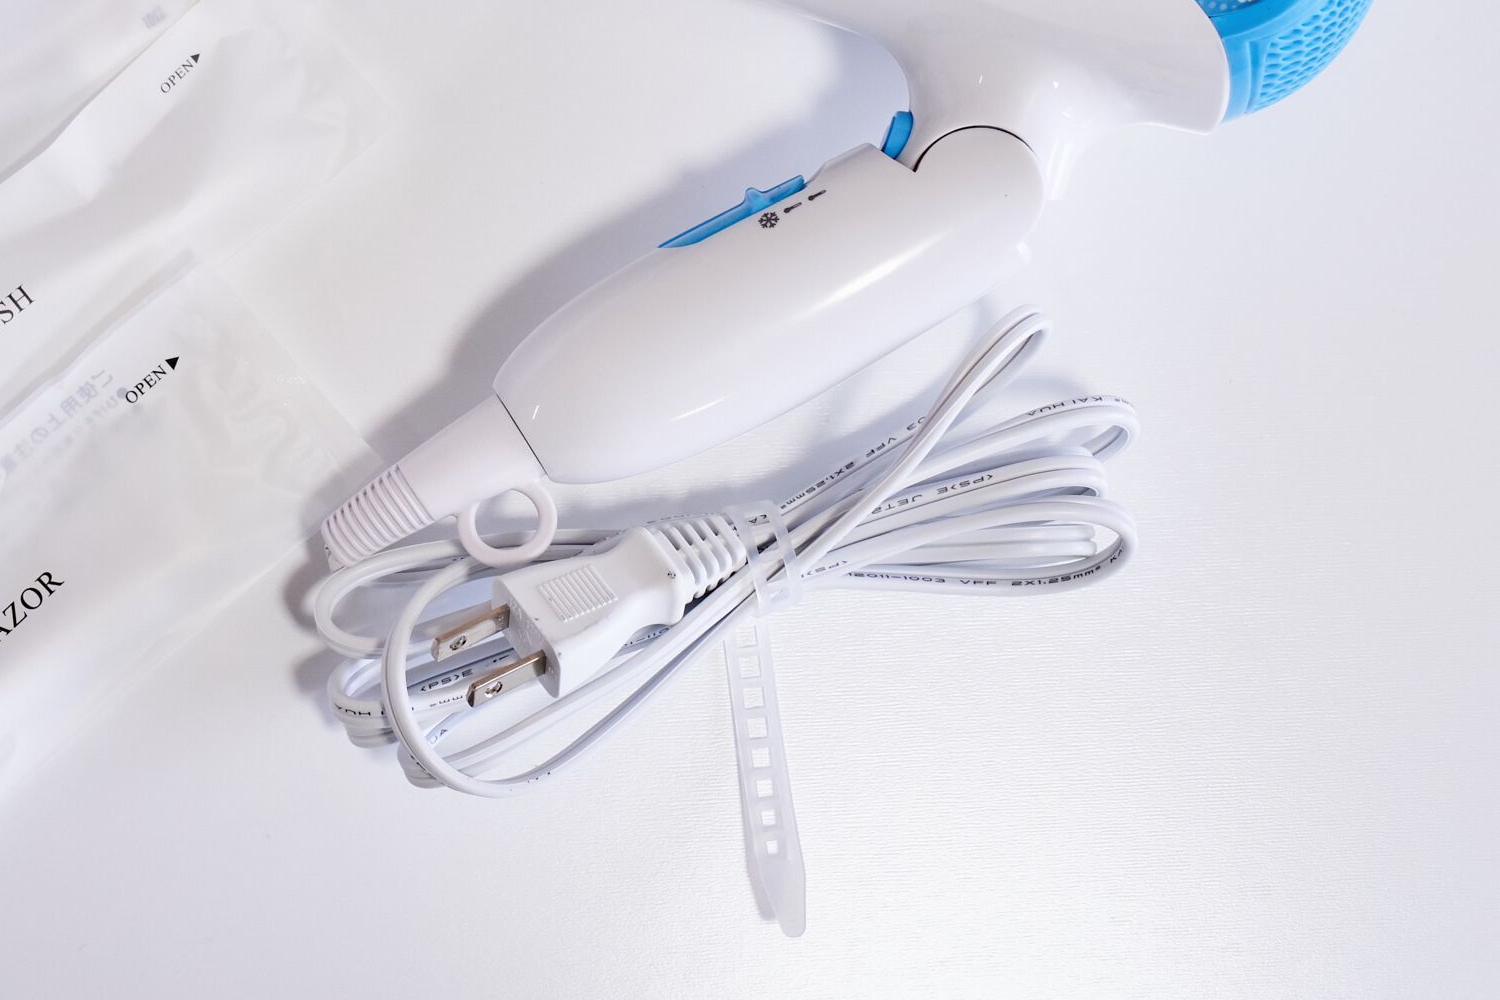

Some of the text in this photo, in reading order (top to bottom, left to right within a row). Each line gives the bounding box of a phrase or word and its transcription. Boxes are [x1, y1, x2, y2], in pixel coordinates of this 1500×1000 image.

[160, 59, 195, 95] OPEN
[125, 364, 168, 404] OPEN
[866, 436, 898, 458] VFF
